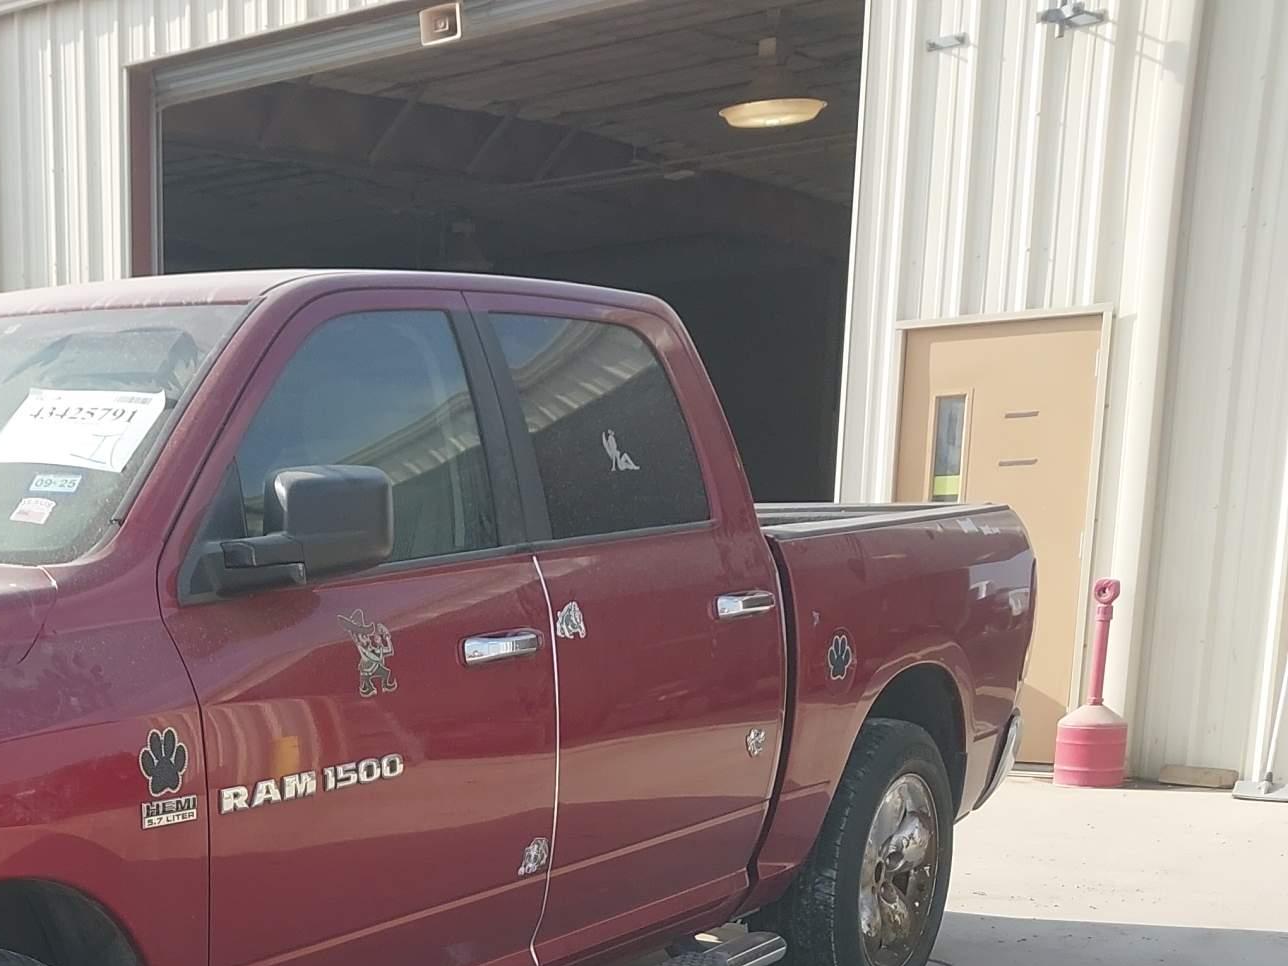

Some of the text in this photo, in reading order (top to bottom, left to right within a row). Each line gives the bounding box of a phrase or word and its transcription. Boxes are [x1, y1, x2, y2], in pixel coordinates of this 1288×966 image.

[30, 406, 138, 423] 43425791
[219, 753, 405, 815] RAM 1500
[144, 796, 196, 818] HEMI
[146, 811, 195, 827] 5.7 LITER
